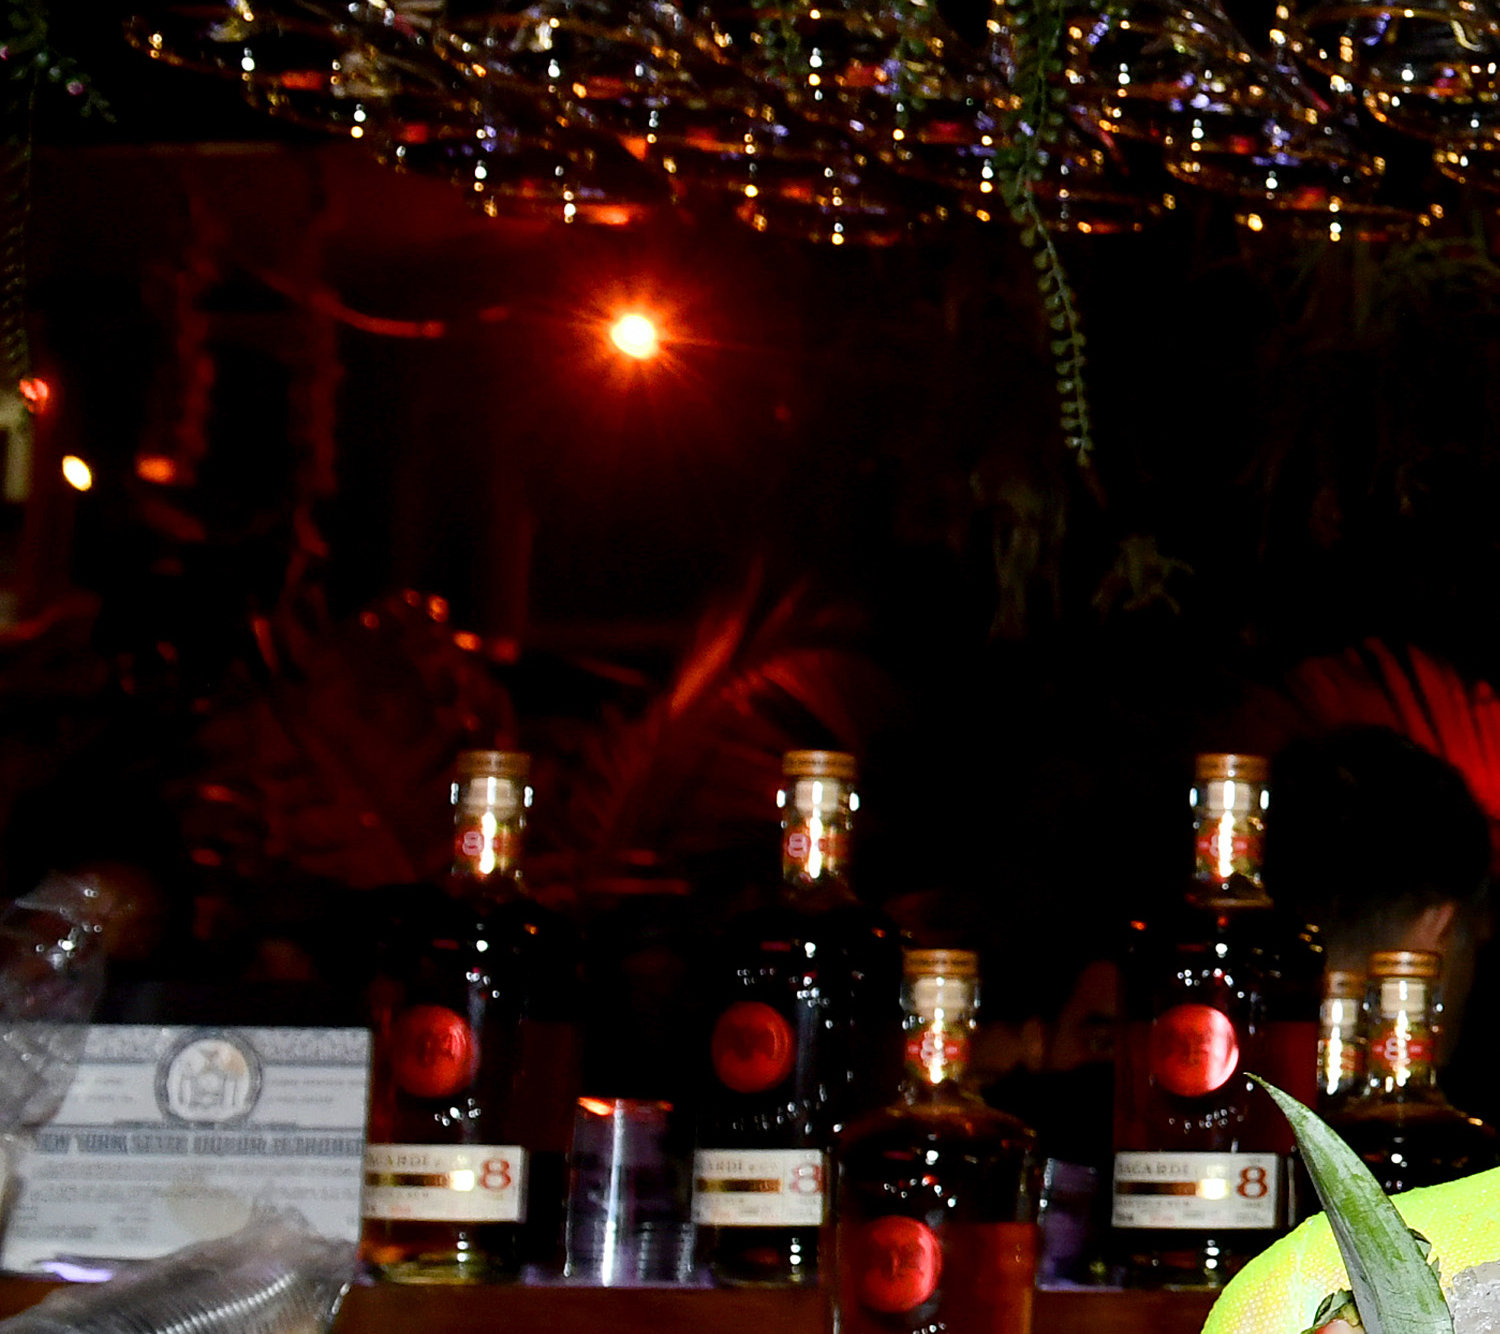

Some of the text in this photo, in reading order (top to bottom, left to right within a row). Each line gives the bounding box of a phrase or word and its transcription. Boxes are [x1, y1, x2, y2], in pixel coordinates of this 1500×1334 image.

[462, 831, 485, 856] 8
[788, 832, 811, 858] 8
[478, 1157, 512, 1193] 8
[788, 1163, 823, 1195] 8
[1237, 1166, 1269, 1199] 8
